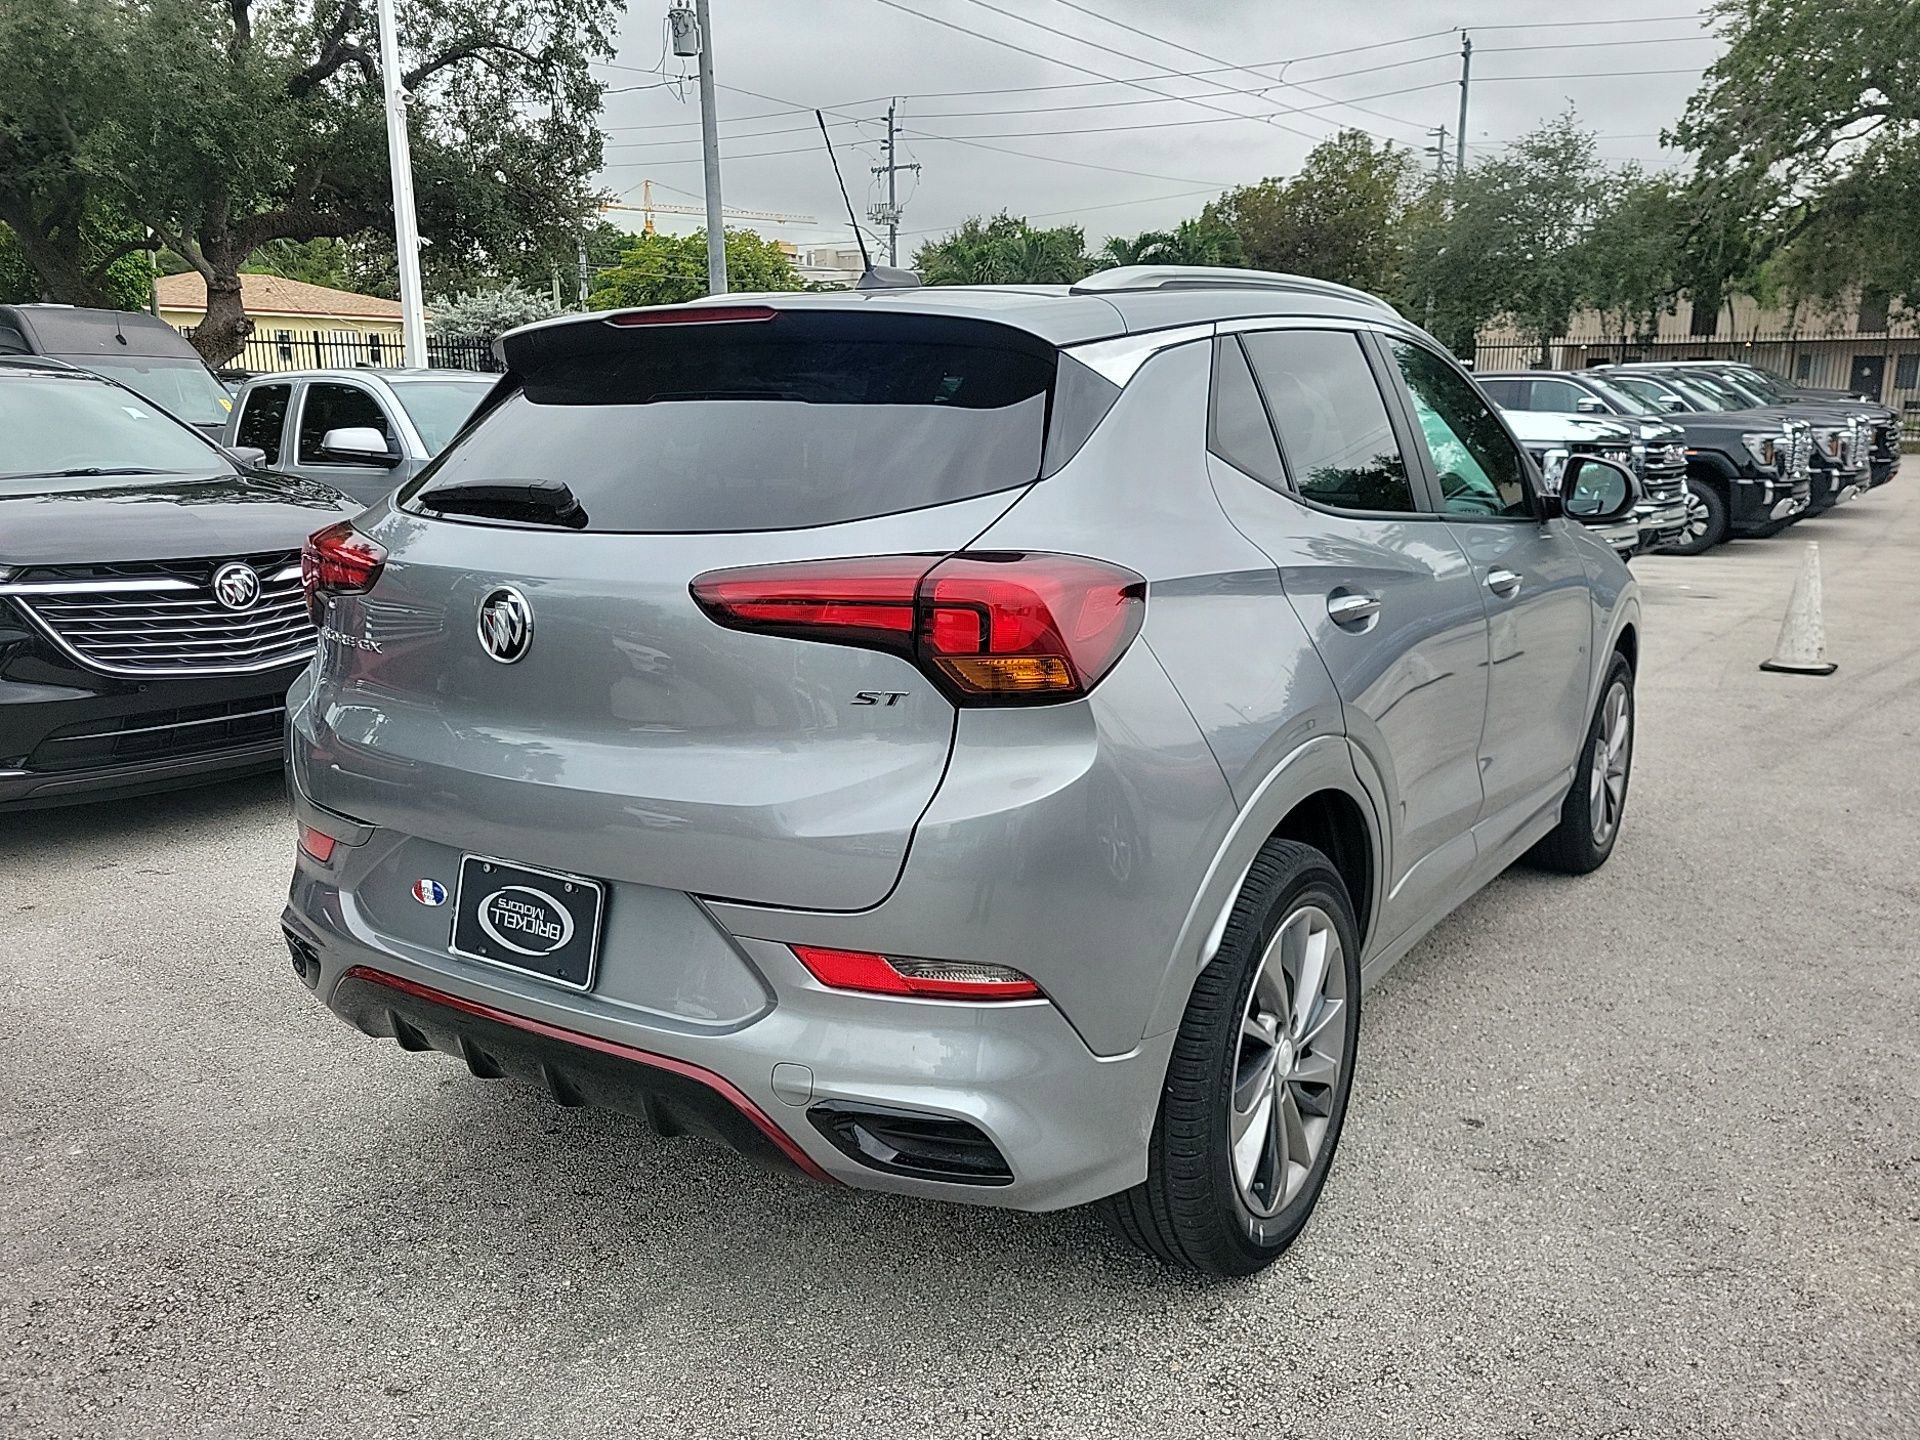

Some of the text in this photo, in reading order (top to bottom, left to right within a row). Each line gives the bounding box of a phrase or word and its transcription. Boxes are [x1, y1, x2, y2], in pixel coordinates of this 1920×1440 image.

[358, 639, 382, 654] GX
[850, 690, 909, 706] ST
[498, 898, 545, 920] Motors
[490, 907, 561, 940] BRICKELL
